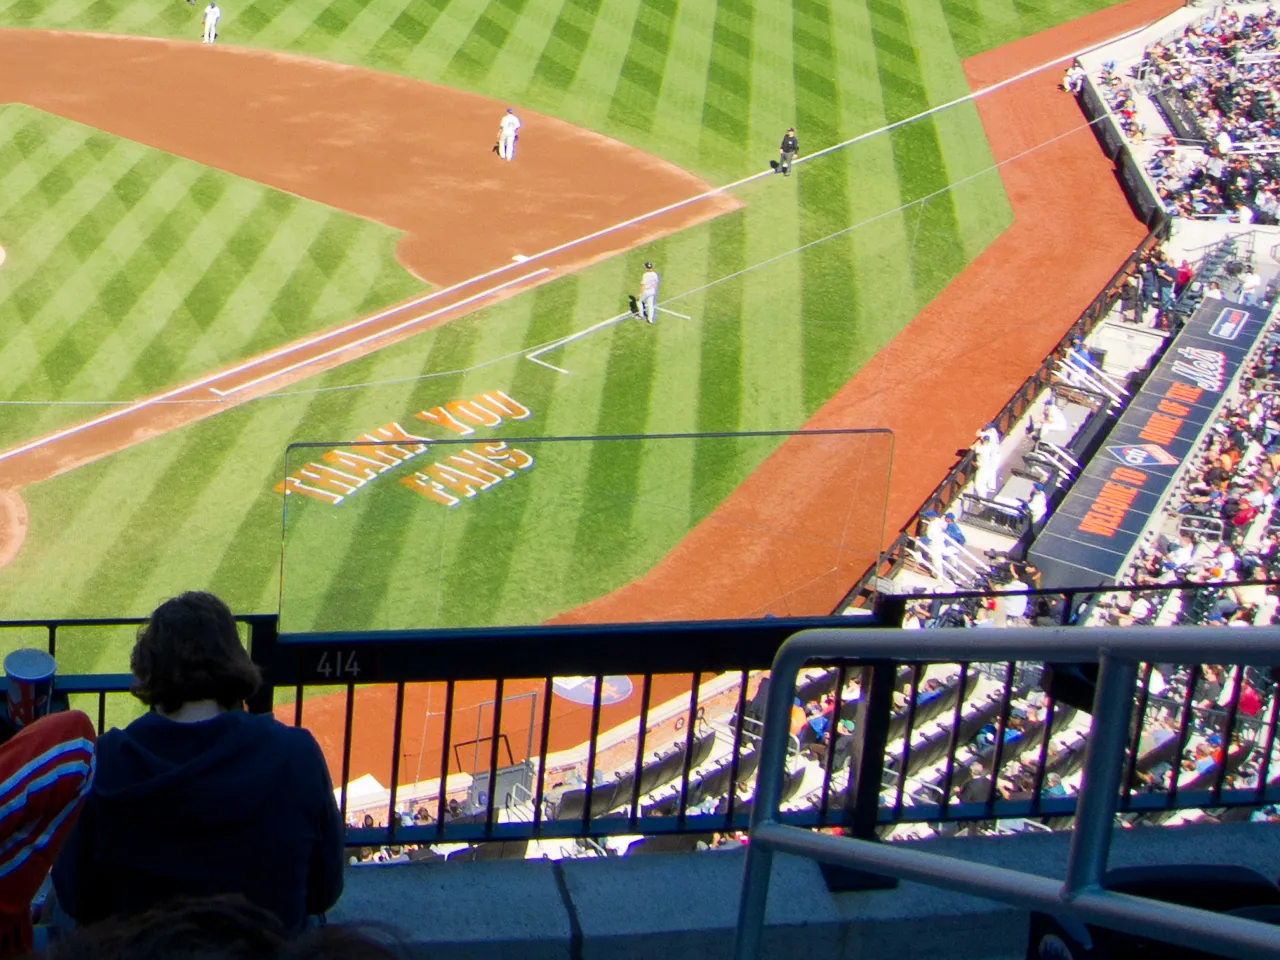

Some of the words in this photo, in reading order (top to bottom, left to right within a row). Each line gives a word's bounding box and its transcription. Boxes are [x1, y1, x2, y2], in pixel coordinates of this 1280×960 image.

[412, 390, 532, 436] YOU
[1138, 412, 1185, 446] HOME
[272, 422, 434, 506] THANK
[399, 441, 535, 508] FANS
[1110, 467, 1150, 486] TO
[1078, 481, 1140, 537] WELCOME
[316, 650, 361, 677] 414
